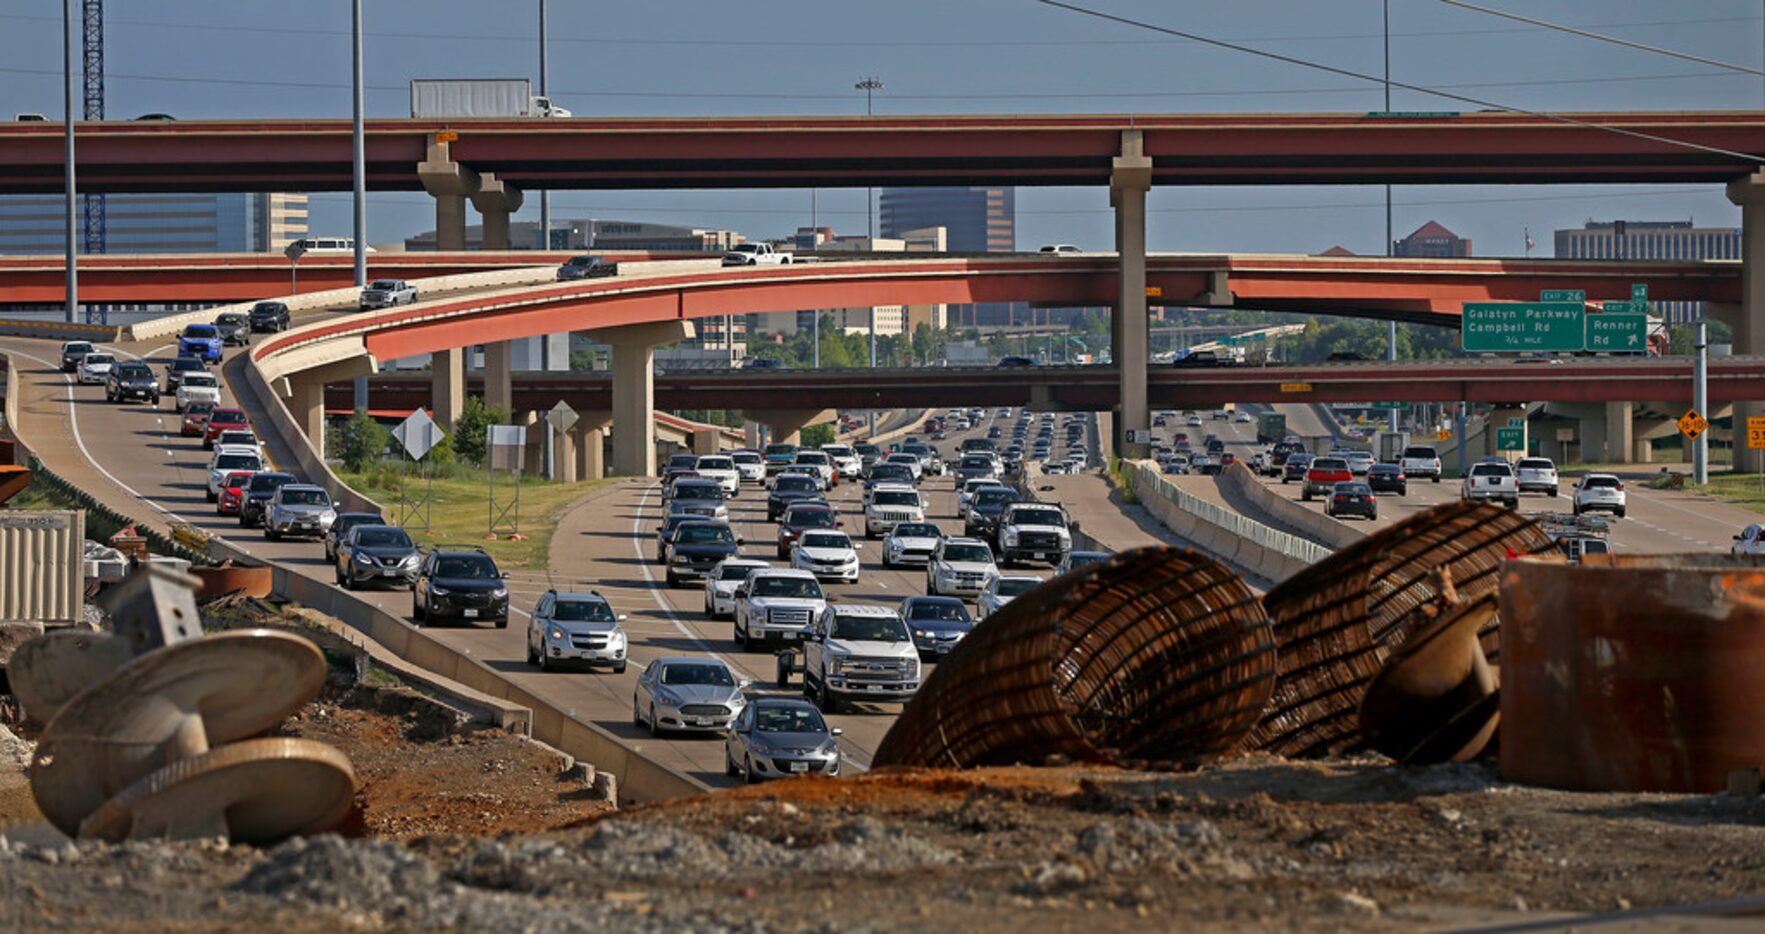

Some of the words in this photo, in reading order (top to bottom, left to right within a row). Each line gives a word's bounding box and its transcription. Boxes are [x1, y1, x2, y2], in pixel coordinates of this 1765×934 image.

[1567, 292, 1581, 300] 26
[1630, 302, 1645, 312] 27
[1468, 309, 1516, 319] Galatyn
[1526, 309, 1578, 319] Parkway
[1468, 322, 1525, 333] Campbell
[1535, 322, 1550, 332] Rd
[1594, 320, 1637, 330] Renner
[1594, 335, 1609, 345] Rd
